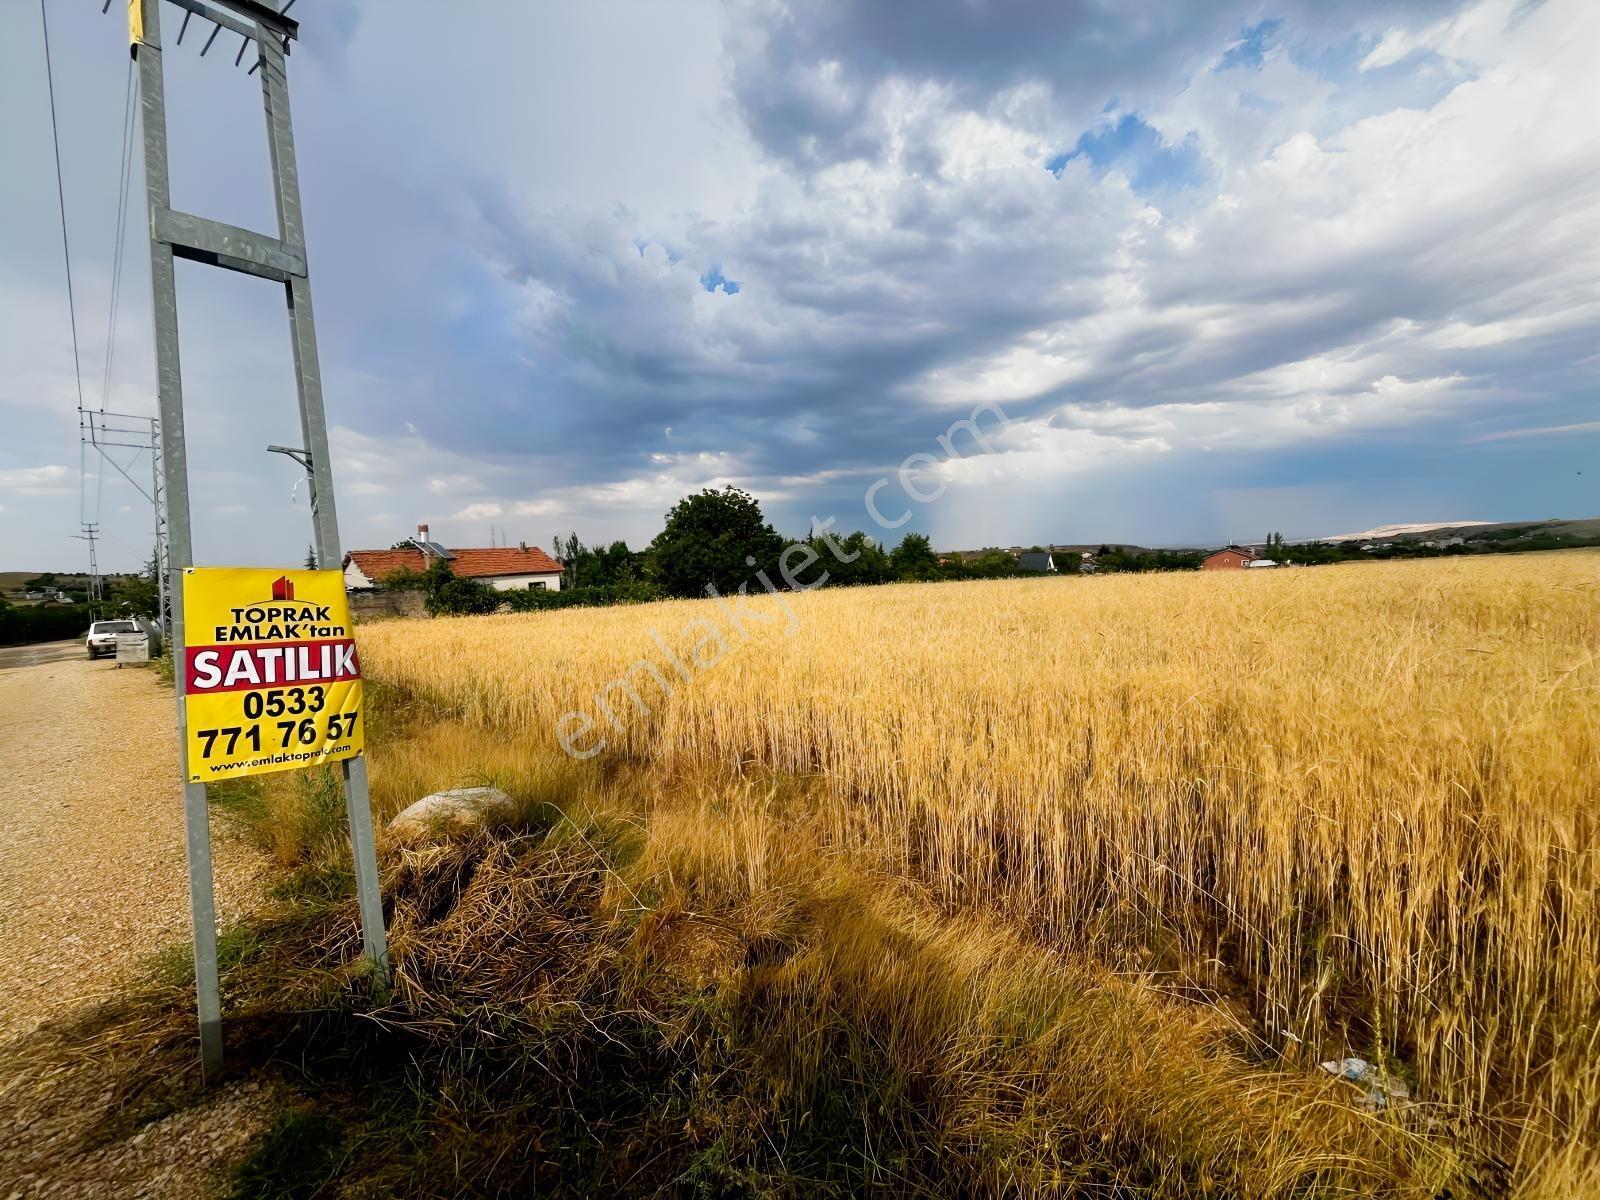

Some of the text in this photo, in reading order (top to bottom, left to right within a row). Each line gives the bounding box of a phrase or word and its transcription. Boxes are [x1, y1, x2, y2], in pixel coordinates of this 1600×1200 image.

[231, 606, 330, 624] TOPRAK
[215, 624, 345, 642] EMLAK'tan
[193, 643, 358, 689] SATILIK
[243, 686, 325, 720] 0533
[197, 712, 358, 759] 771 76 57
